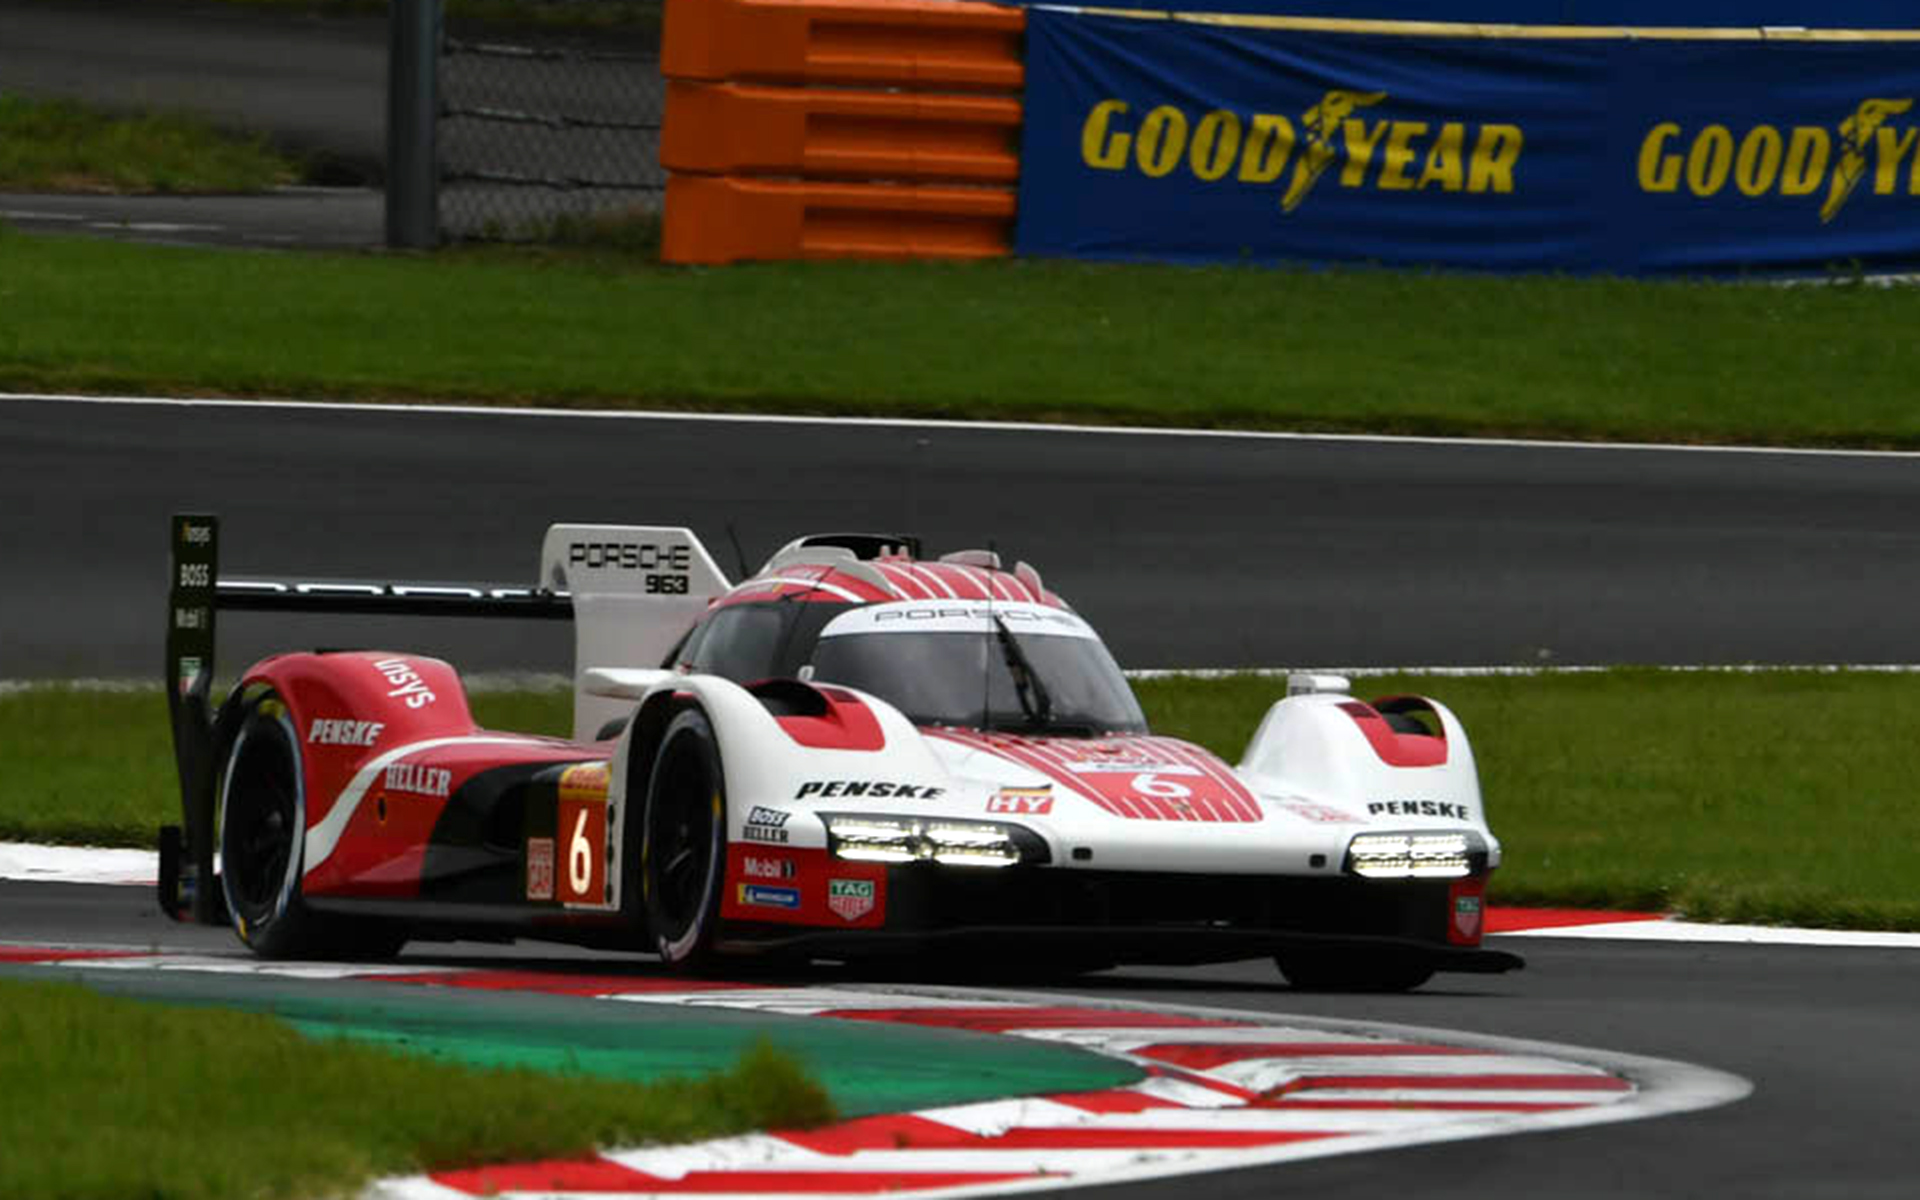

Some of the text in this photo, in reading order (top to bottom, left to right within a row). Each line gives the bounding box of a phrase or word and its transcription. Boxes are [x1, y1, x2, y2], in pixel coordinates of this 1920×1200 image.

[1638, 122, 1920, 197] GOODY
[570, 543, 690, 570] PORSCHE
[180, 563, 209, 587] BOSS
[645, 574, 689, 595] 963
[308, 718, 387, 746] PENSKE
[795, 781, 946, 800] PENSKE
[1130, 774, 1193, 798] 6
[751, 808, 785, 825] BOSS
[1367, 800, 1469, 820] PENSKE
[569, 808, 592, 895] 6
[744, 857, 781, 879] Mobil
[835, 882, 870, 896] TAG
